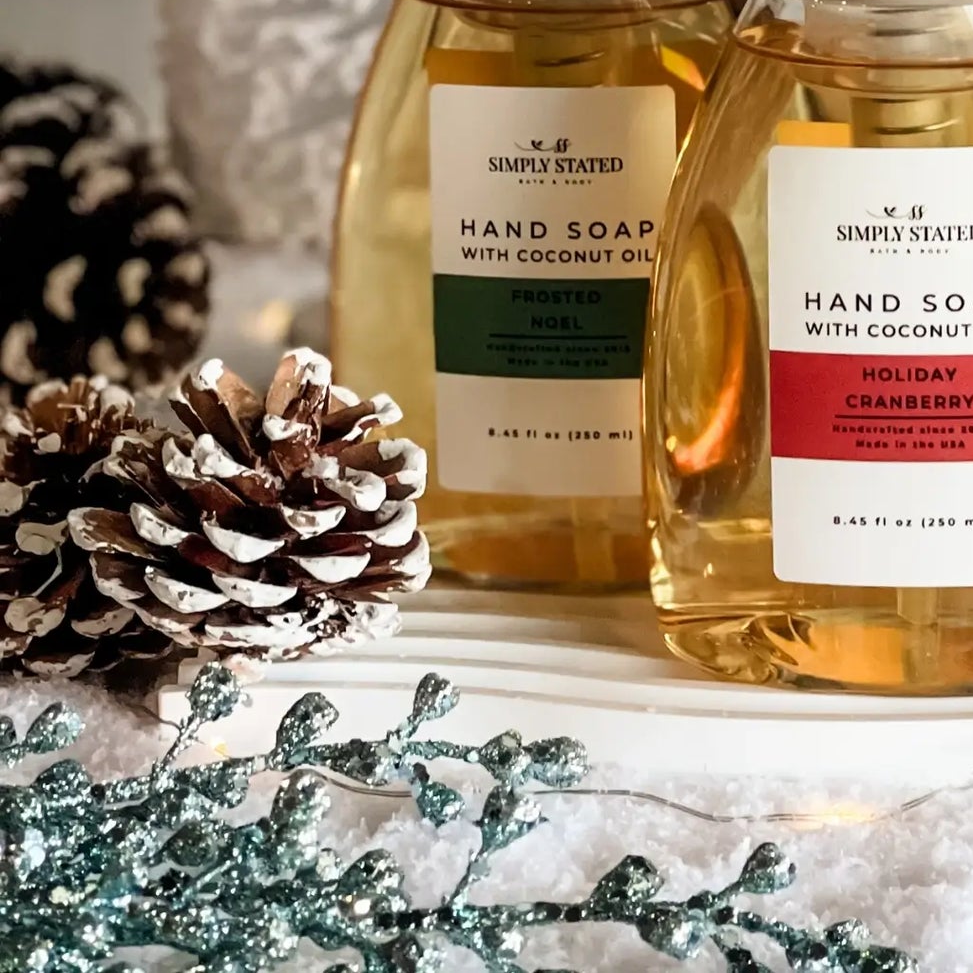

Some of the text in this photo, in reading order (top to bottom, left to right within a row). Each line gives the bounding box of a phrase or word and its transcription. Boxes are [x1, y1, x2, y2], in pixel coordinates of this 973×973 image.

[488, 157, 623, 174] SIMPLY STATED
[461, 219, 654, 239] HAND SOAP
[837, 225, 905, 242] SIMPLY
[462, 247, 653, 263] WITH COCONUT OIL
[512, 290, 602, 304] FROSTED
[805, 292, 901, 312] HAND
[530, 316, 584, 330] NOEL
[805, 322, 858, 337] WITH
[867, 324, 972, 337] COCONUT
[863, 367, 957, 382] HOLIDAY
[569, 430, 600, 441] (250
[856, 440, 965, 448] Made in the USA
[833, 516, 866, 526] 8.45
[876, 517, 886, 526] fl
[896, 518, 911, 527] oz
[922, 517, 955, 528] (250
